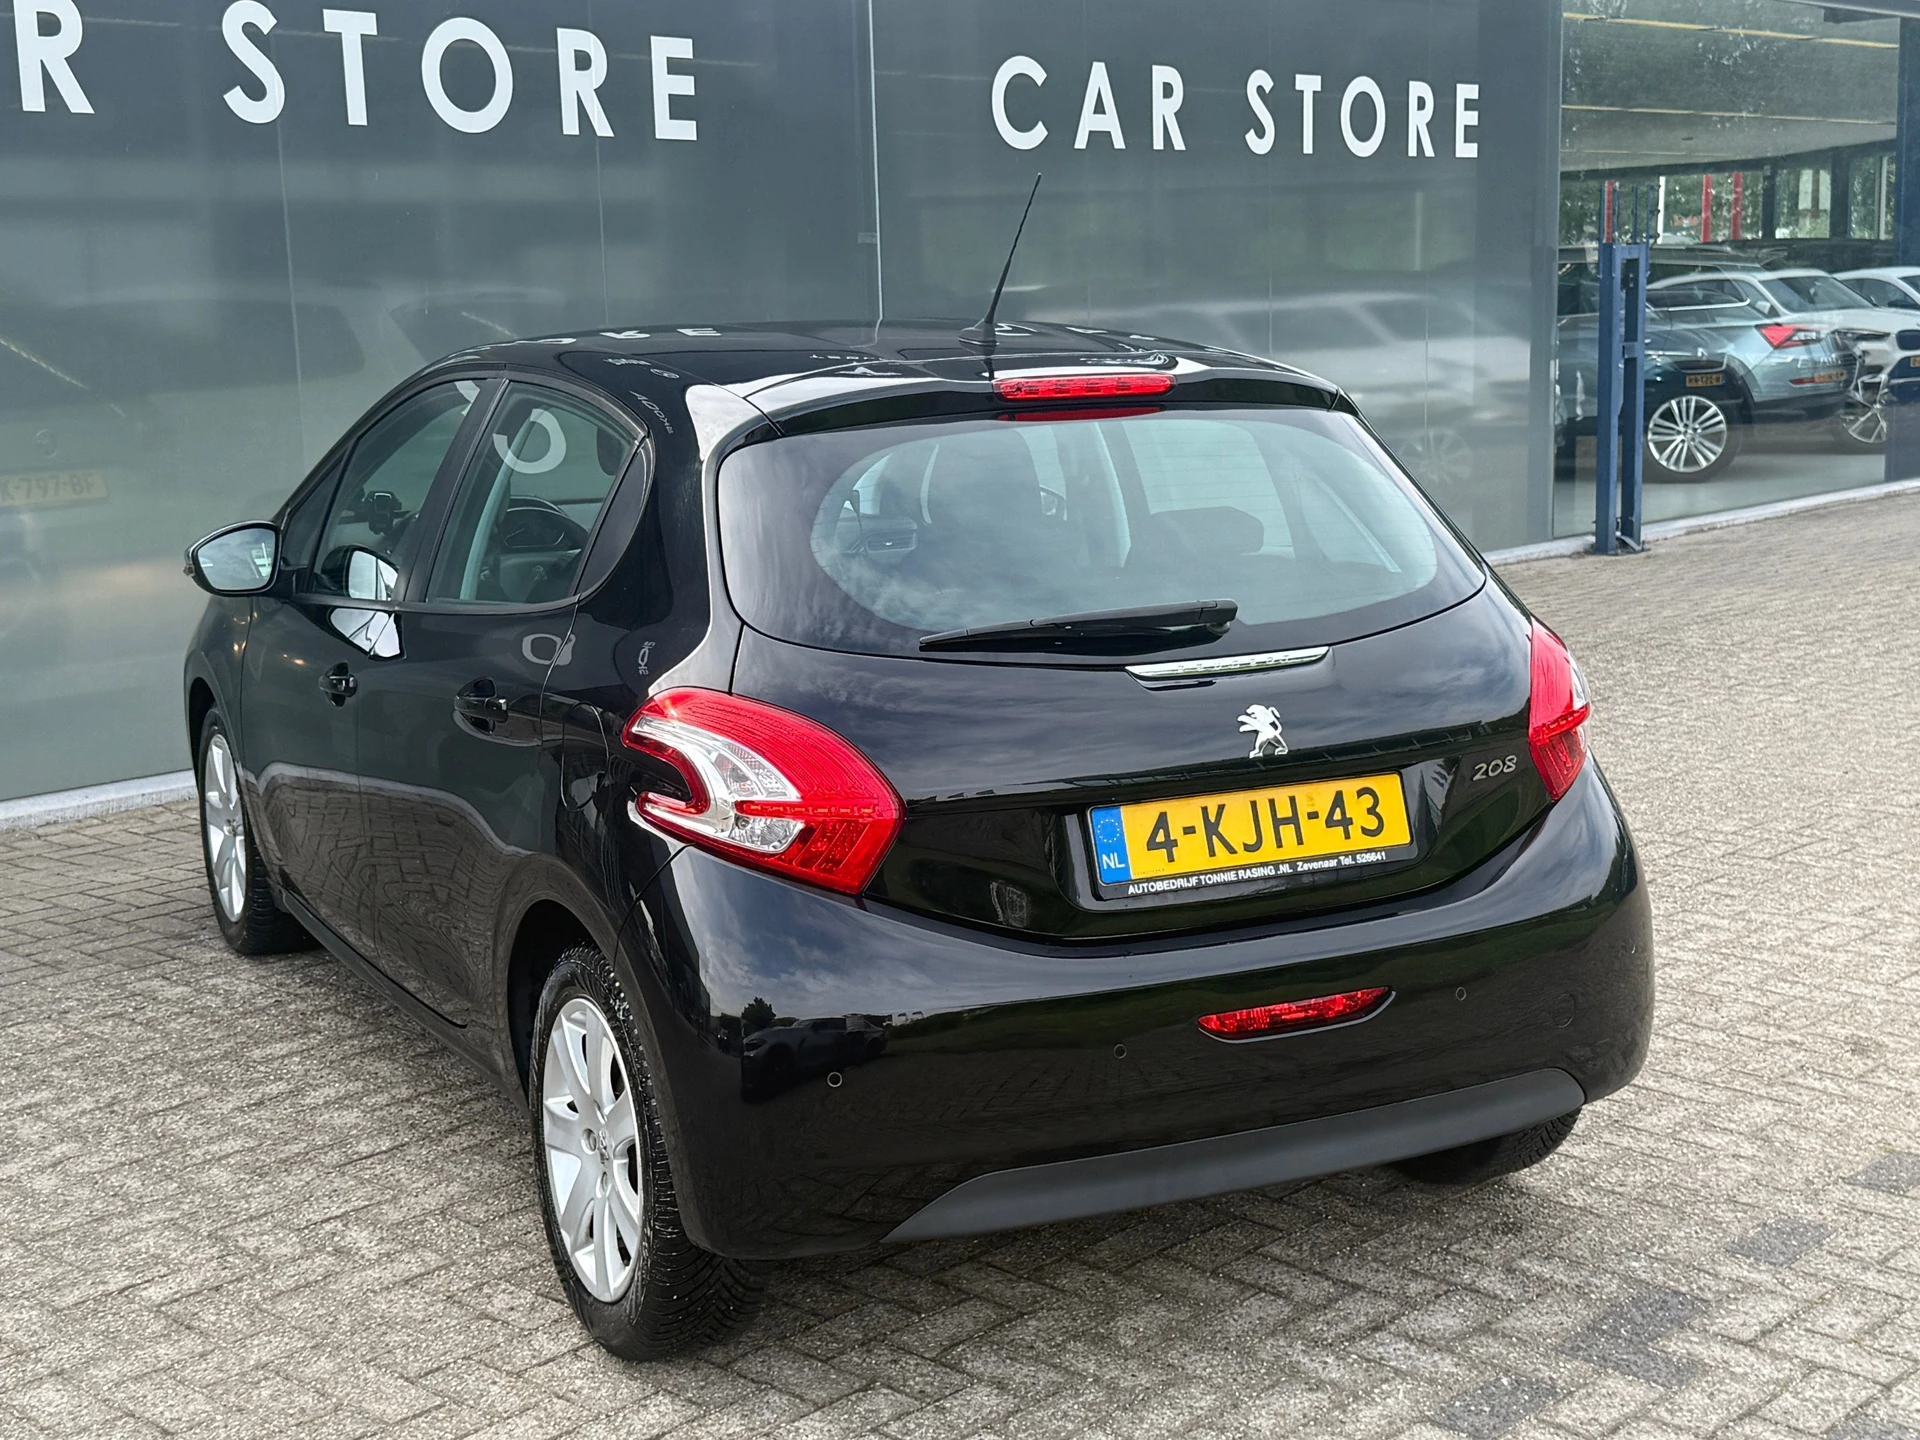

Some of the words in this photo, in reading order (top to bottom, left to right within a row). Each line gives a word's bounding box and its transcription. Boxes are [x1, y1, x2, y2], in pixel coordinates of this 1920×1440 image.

[13, 0, 95, 114] R
[222, 0, 698, 141] STORE
[991, 55, 1187, 150] CAR
[1245, 69, 1480, 159] STORE
[1472, 754, 1518, 781] 208
[1146, 786, 1385, 863] 4-KJH-43
[1102, 852, 1125, 870] NL
[1128, 876, 1200, 896] AUTOBEDRIJF
[1201, 871, 1238, 885] TONNIE
[1238, 865, 1276, 880] RASING
[1296, 858, 1338, 872] Zevenaar
